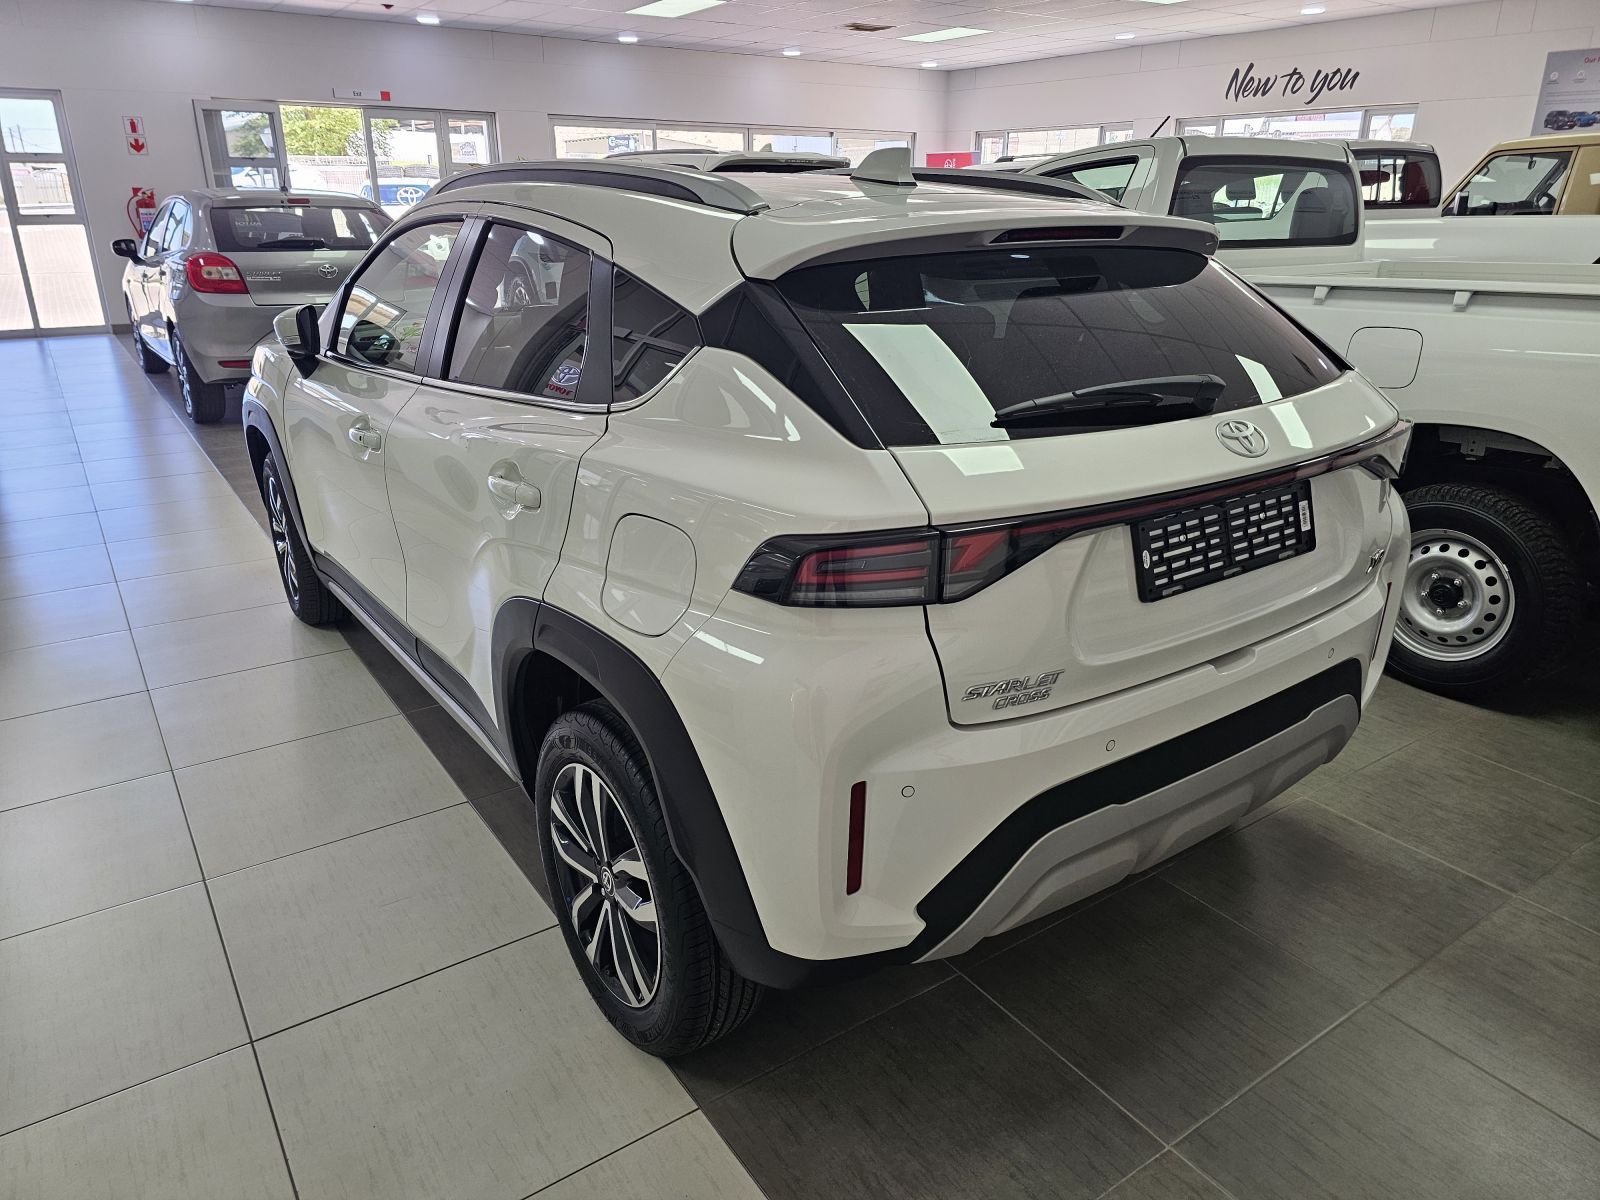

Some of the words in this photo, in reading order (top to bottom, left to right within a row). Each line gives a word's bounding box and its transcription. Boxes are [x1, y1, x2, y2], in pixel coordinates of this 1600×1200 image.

[1225, 62, 1277, 102] New
[1280, 67, 1305, 98] to
[1304, 67, 1360, 105] you
[546, 383, 574, 396] TOYOT
[961, 669, 1066, 701] STARLET
[992, 687, 1052, 710] CROSS
